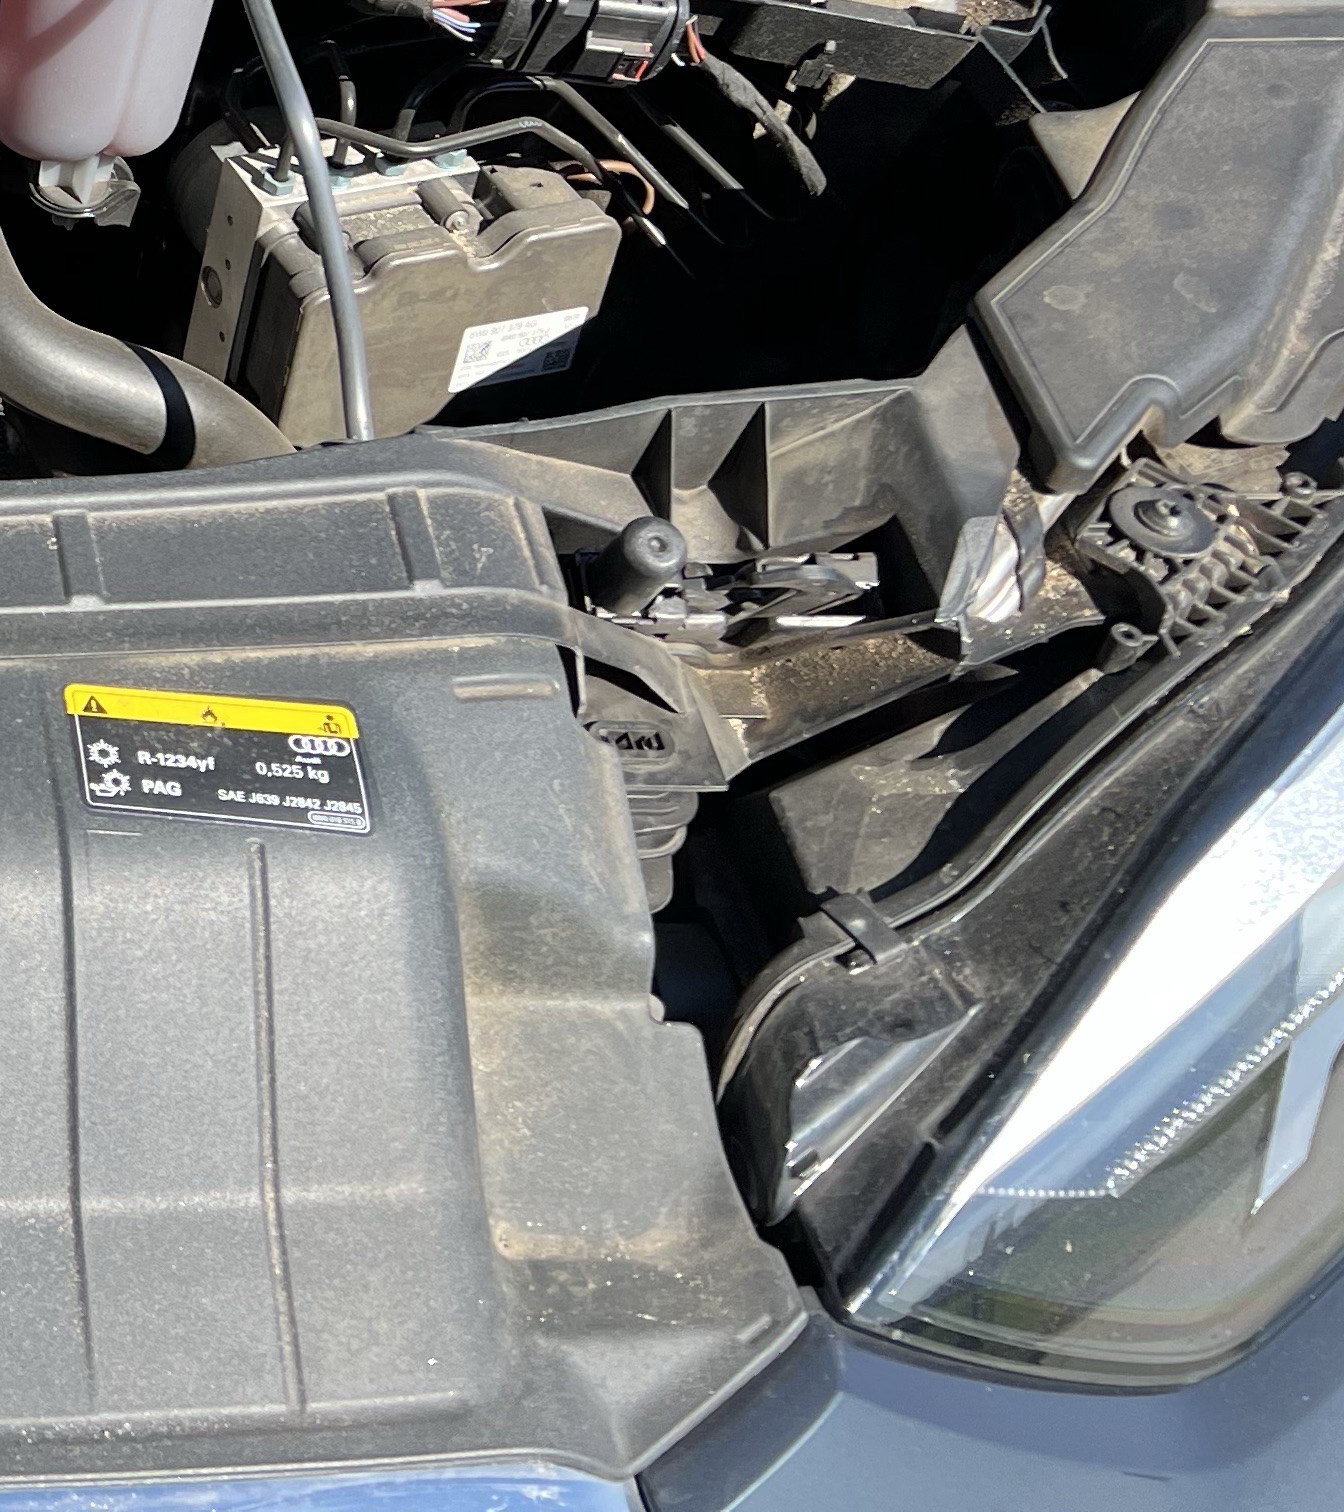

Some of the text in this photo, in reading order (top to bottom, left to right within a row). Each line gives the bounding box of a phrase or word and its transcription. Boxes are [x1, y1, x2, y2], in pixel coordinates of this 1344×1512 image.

[137, 750, 216, 773] R-1234yf
[307, 769, 330, 784] kg
[141, 779, 183, 797] PAG
[217, 788, 246, 803] SAE
[248, 791, 280, 807] J639
